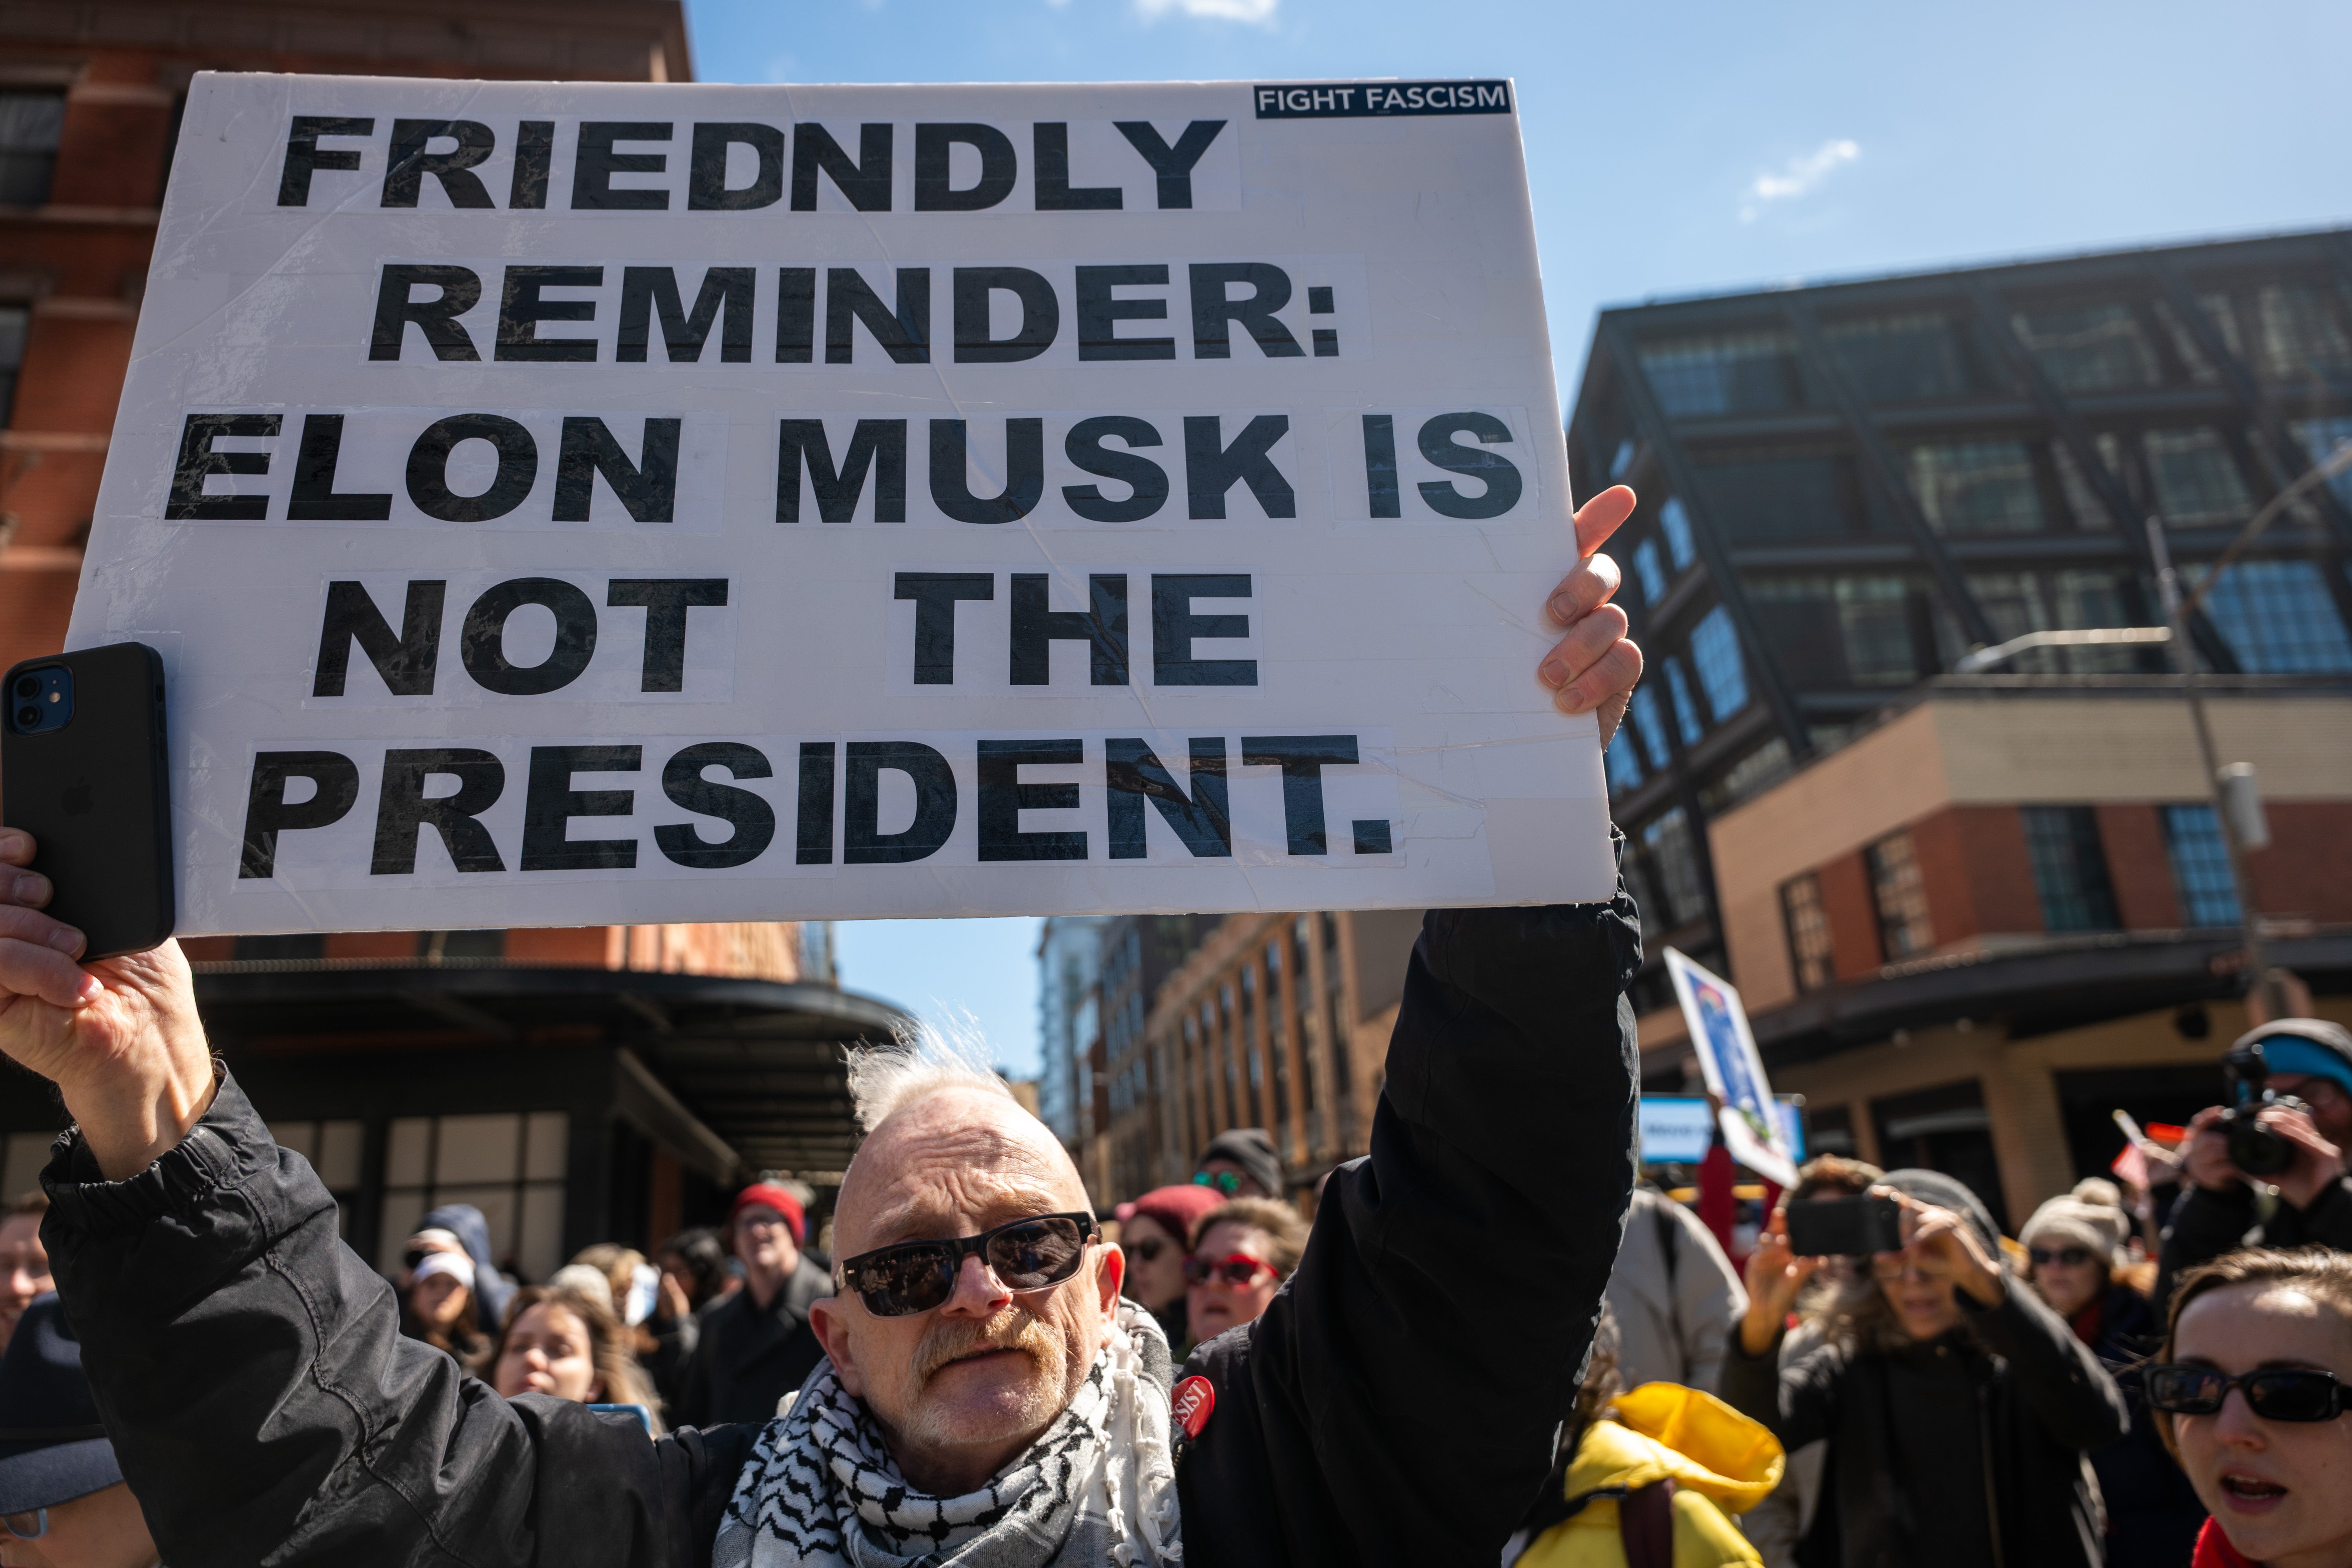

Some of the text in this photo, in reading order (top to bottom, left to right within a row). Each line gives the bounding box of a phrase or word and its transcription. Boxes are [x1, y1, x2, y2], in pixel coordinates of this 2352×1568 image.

[1258, 85, 1506, 111] FIGHT FASCISM
[277, 116, 1228, 212] FRIEDNDLY
[368, 263, 1339, 364] REMINDER:
[164, 412, 1522, 524] ELON MUSK IS
[312, 572, 1258, 697] NOT THE
[238, 735, 1392, 879] PRESIDENT.
[1171, 1379, 1207, 1426] ESIST
